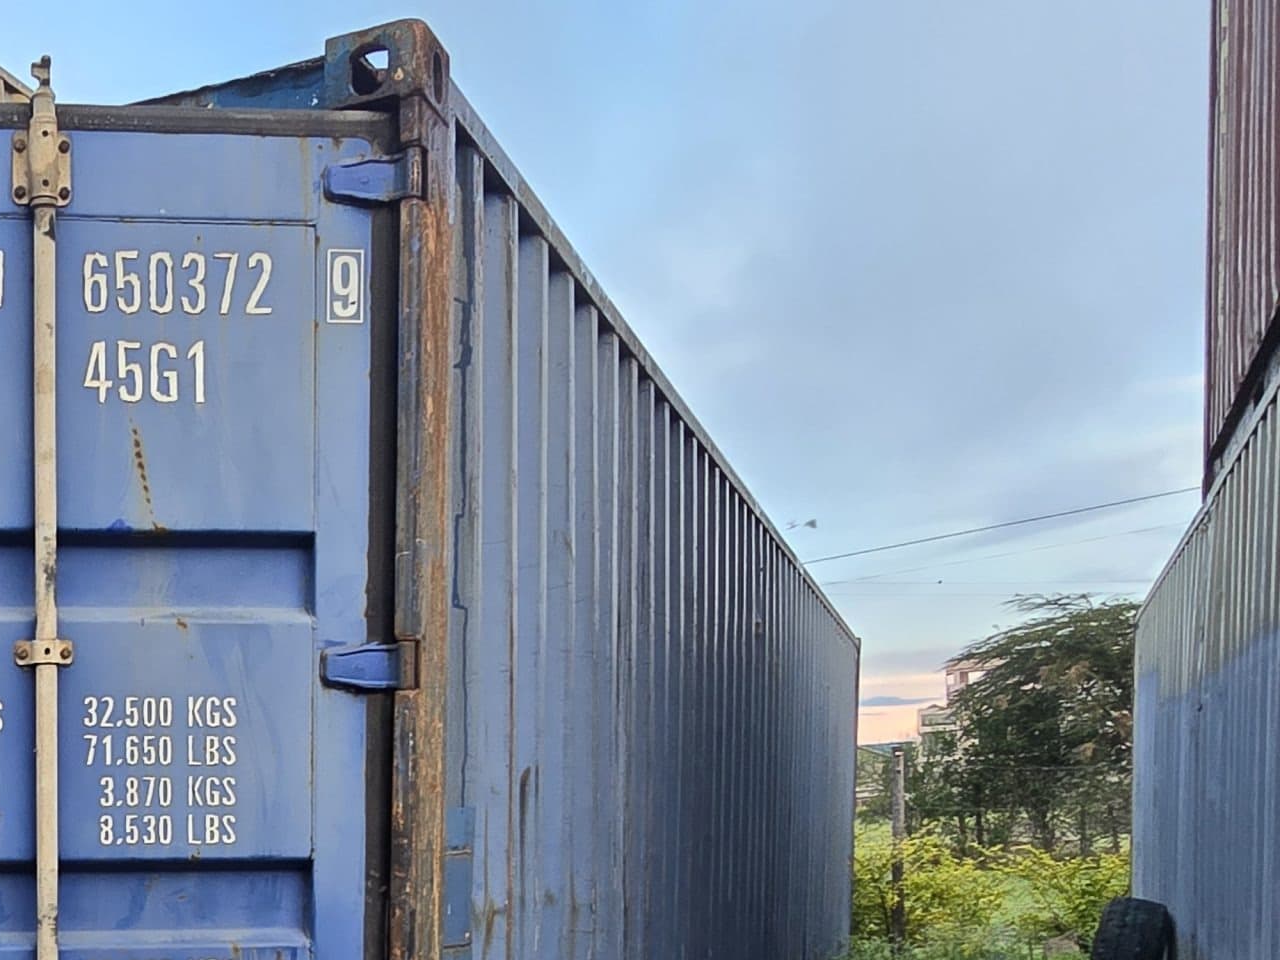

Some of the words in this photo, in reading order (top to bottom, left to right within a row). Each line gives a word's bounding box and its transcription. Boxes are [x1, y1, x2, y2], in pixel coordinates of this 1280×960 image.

[83, 249, 274, 316] 650372
[331, 254, 360, 319] 9
[83, 339, 208, 404] 45G1
[187, 695, 238, 728] KGS
[187, 734, 237, 766] LBS
[187, 775, 237, 807] KGS
[187, 813, 237, 845] LBS
